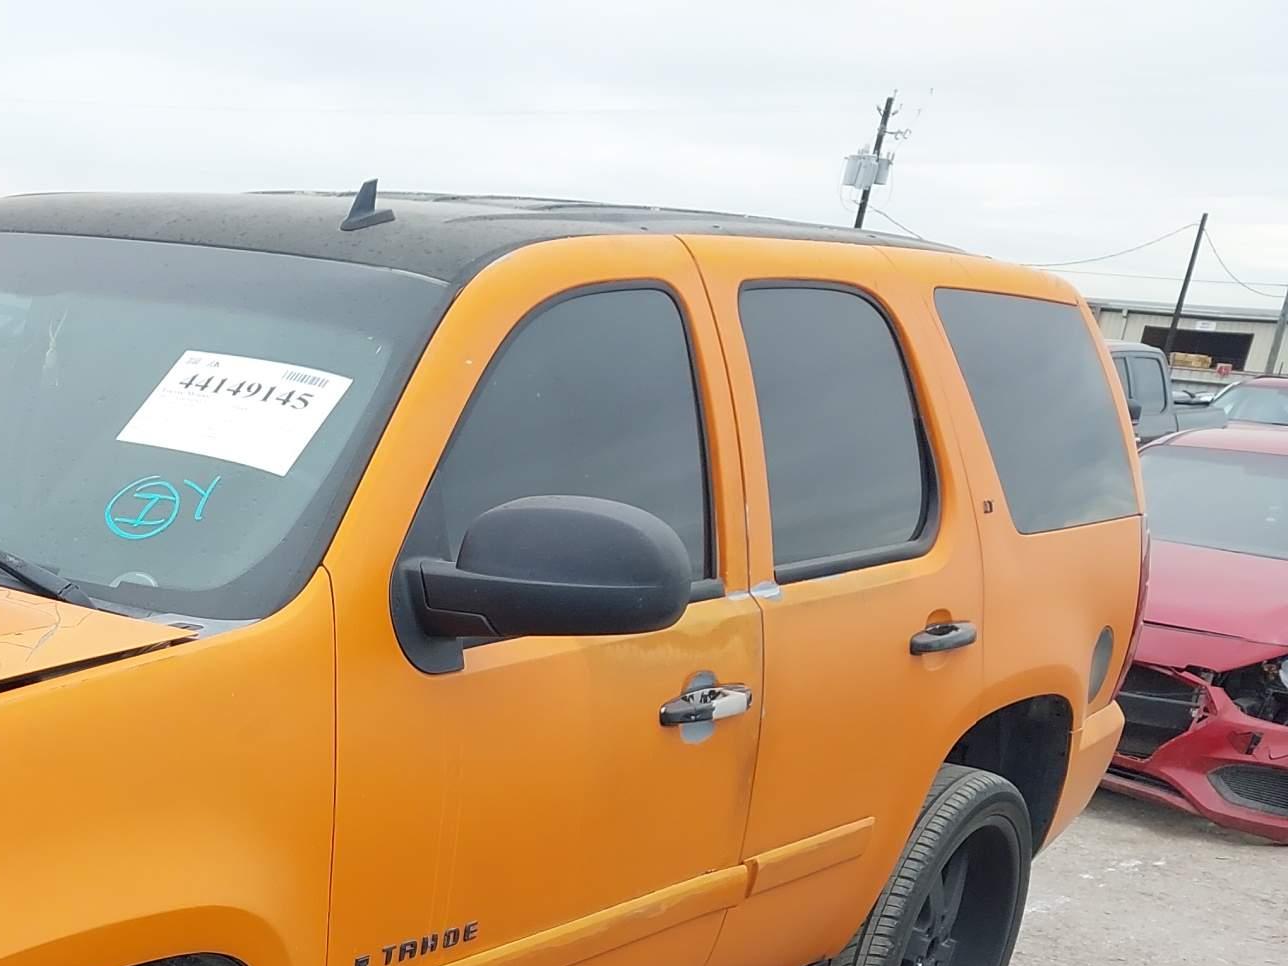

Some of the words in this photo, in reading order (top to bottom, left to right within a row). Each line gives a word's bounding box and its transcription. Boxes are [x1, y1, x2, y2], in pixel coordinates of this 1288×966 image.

[179, 374, 315, 410] 44149145
[184, 476, 222, 521] Y
[382, 920, 479, 966] TAHOE
